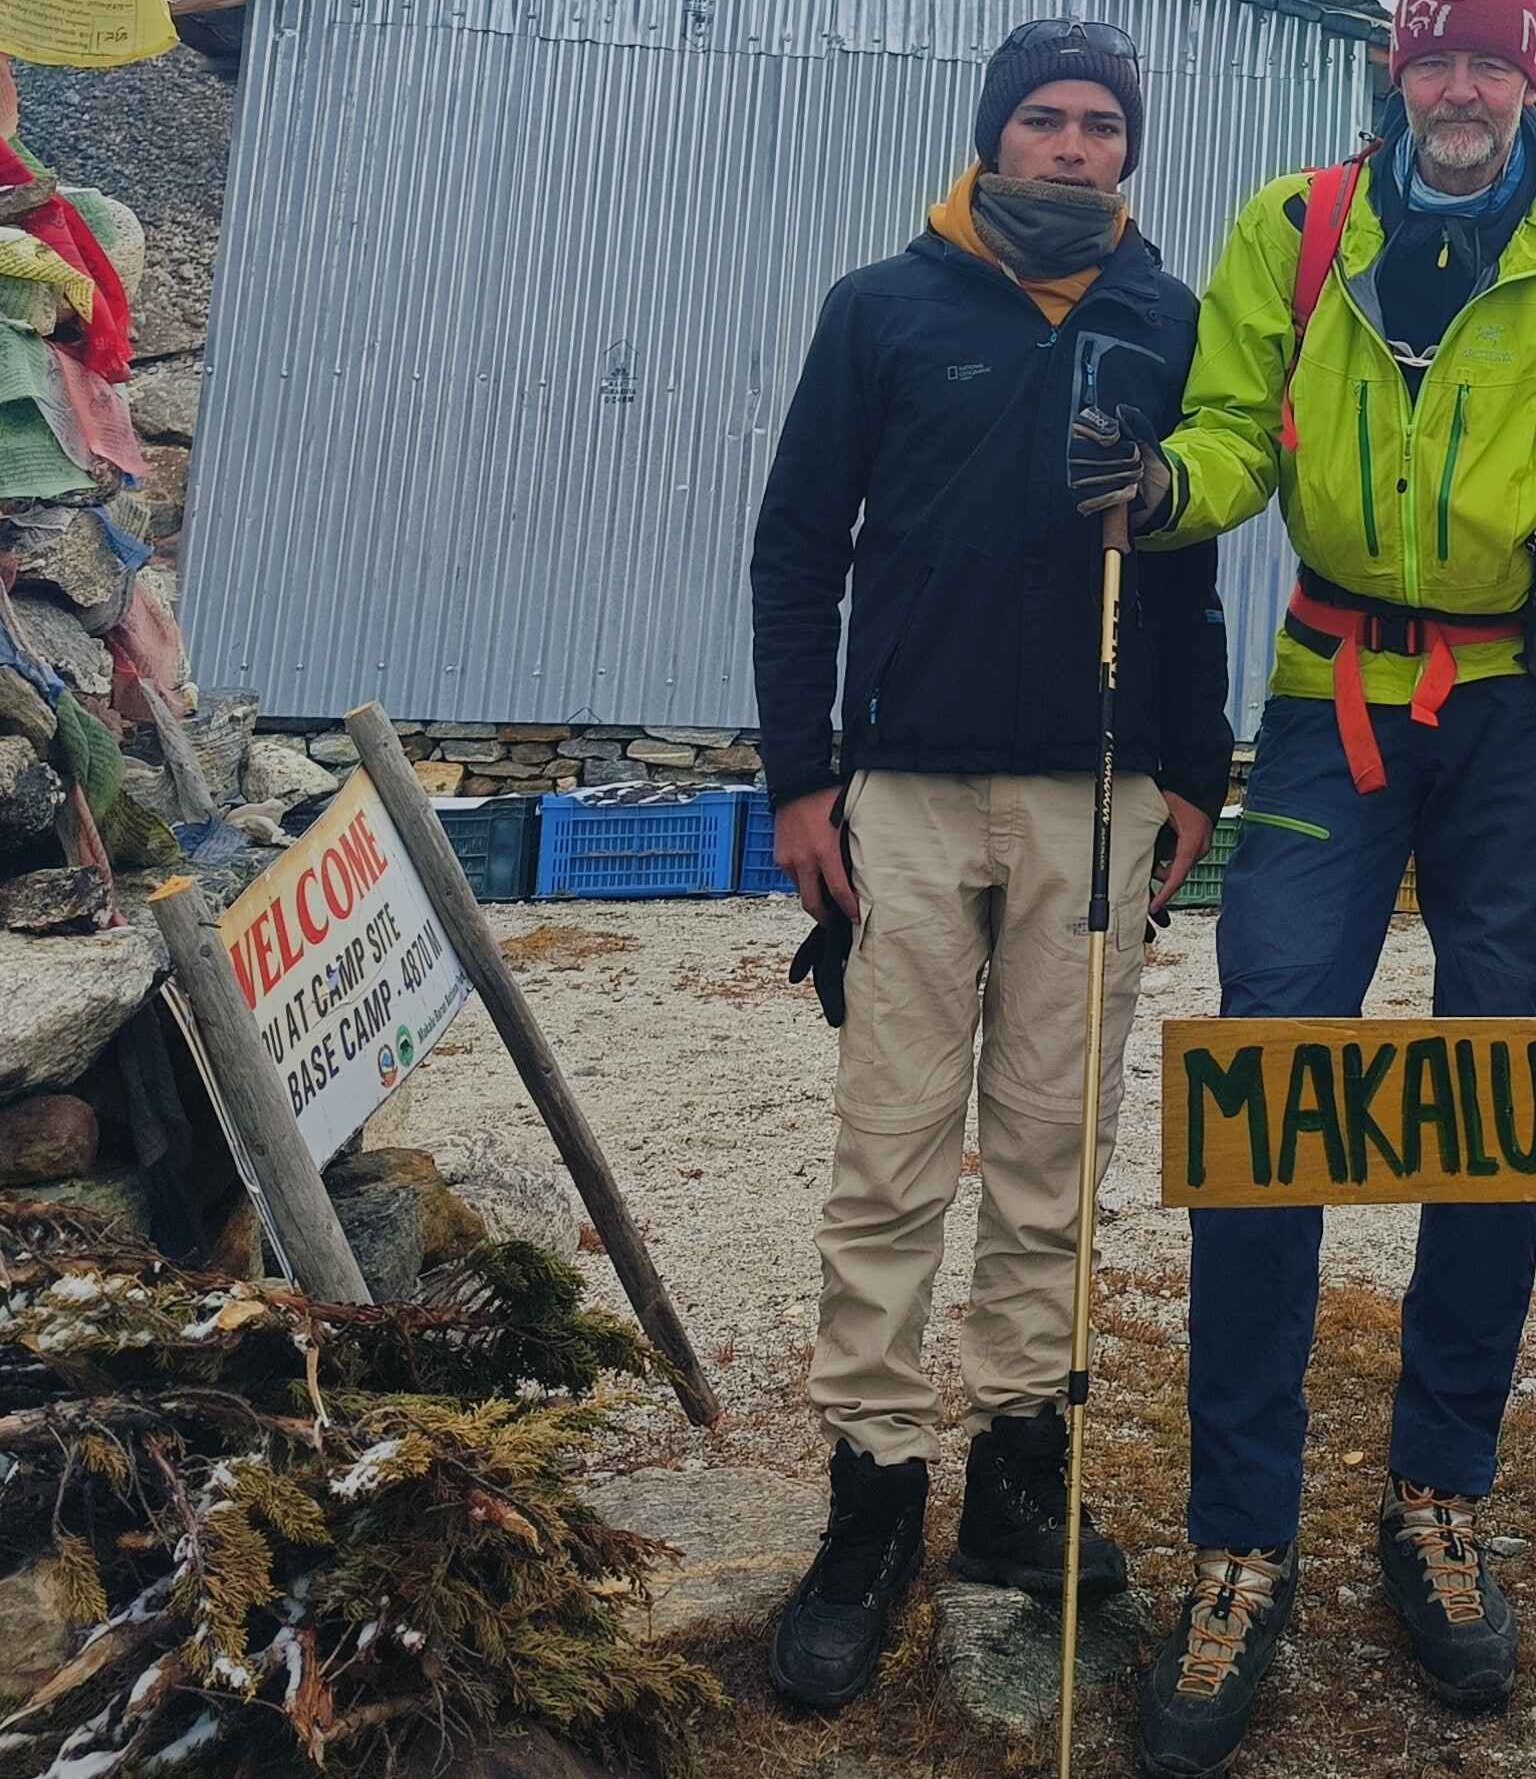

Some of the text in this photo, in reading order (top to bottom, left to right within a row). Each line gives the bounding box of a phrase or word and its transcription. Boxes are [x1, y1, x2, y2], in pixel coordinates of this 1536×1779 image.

[284, 988, 310, 1049] AT
[311, 936, 365, 1018] CAMP
[366, 902, 401, 964] SITE
[287, 1033, 340, 1118] BASE
[339, 979, 392, 1062] CAMP
[400, 933, 433, 994] 4870
